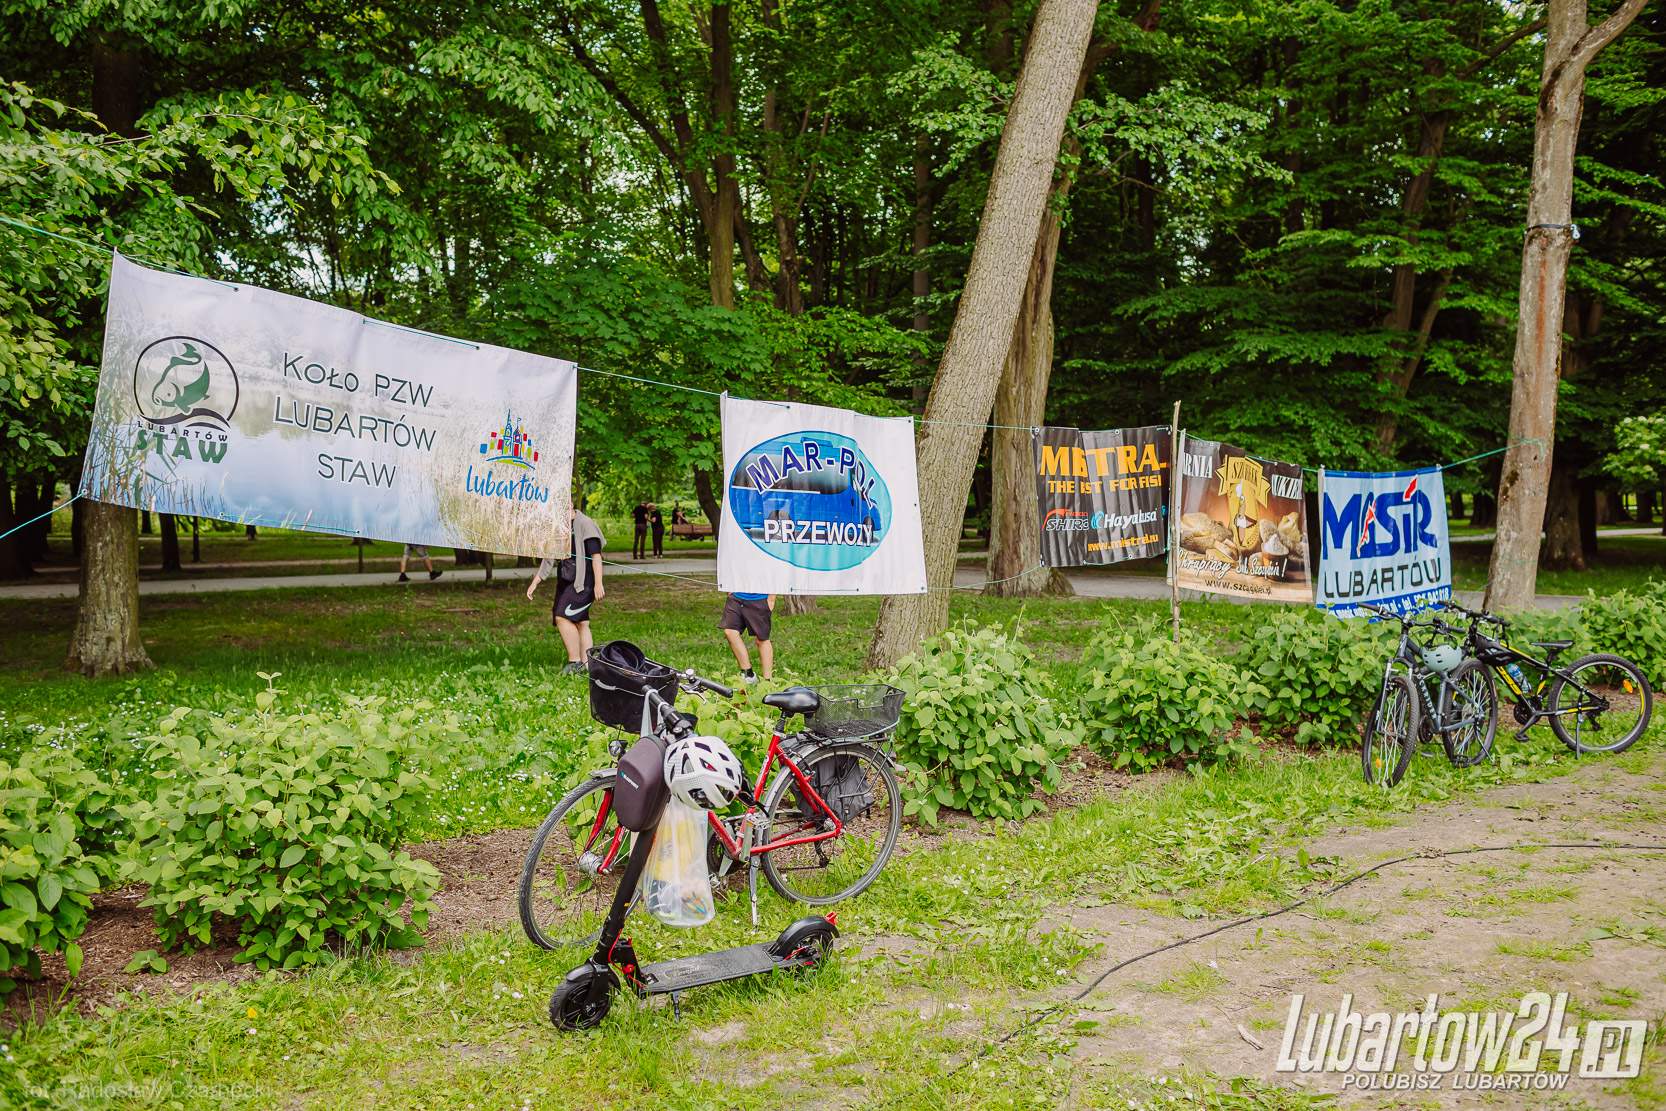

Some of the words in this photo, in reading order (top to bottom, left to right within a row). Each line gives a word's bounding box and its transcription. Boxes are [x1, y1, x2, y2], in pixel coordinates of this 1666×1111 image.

[374, 373, 434, 408] PZW
[138, 420, 227, 442] LUBARTÓW
[275, 396, 437, 452] LUBARTÓW
[137, 429, 228, 464] STAW
[317, 453, 396, 489] STAW
[1047, 481, 1075, 494] THE
[764, 519, 873, 547] PRZEWOZY
[1324, 555, 1441, 598] LUBARTÓW
